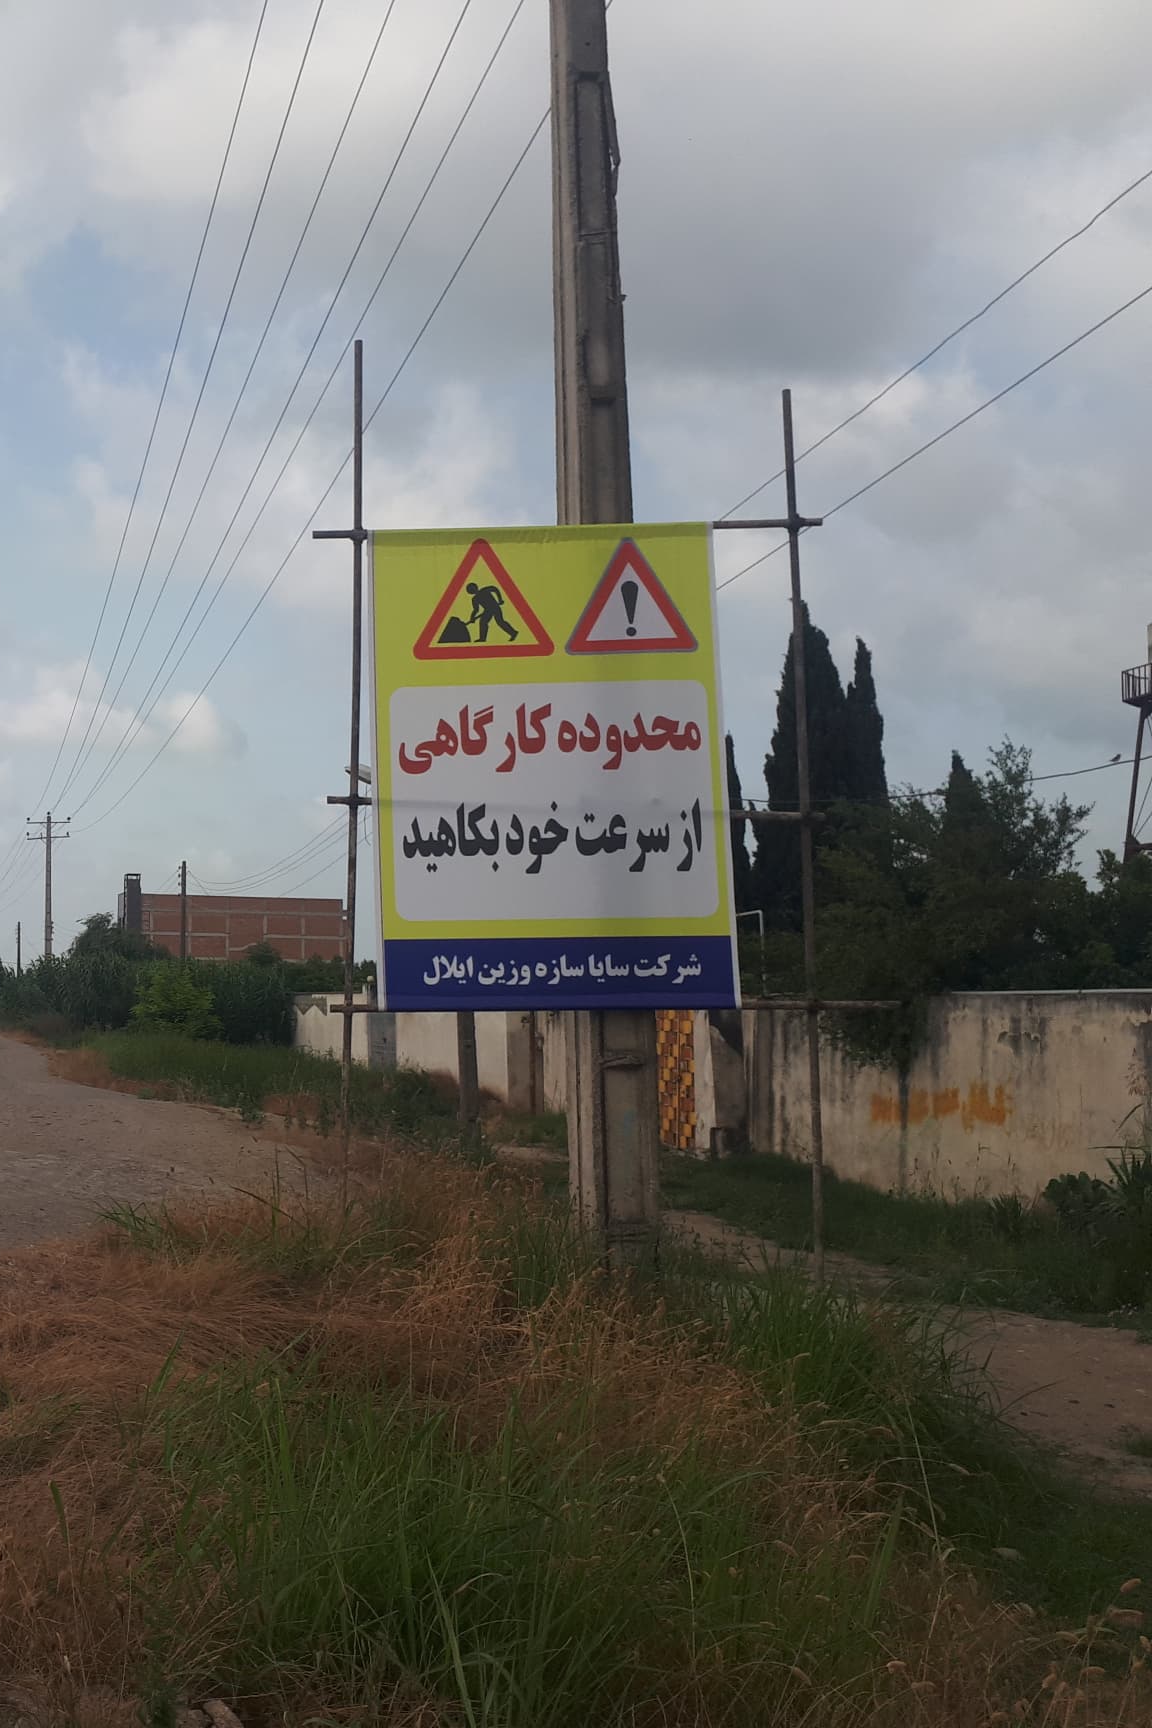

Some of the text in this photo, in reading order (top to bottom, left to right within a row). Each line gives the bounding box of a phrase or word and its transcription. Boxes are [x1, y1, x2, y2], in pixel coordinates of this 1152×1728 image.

[399, 704, 702, 775] محدوده کارگاهی
[402, 797, 703, 875] از سرعت خود بکاهید
[423, 956, 474, 985] ایلال
[535, 955, 584, 985] سازه
[588, 954, 629, 983] سایا
[633, 954, 701, 985] شرکت
